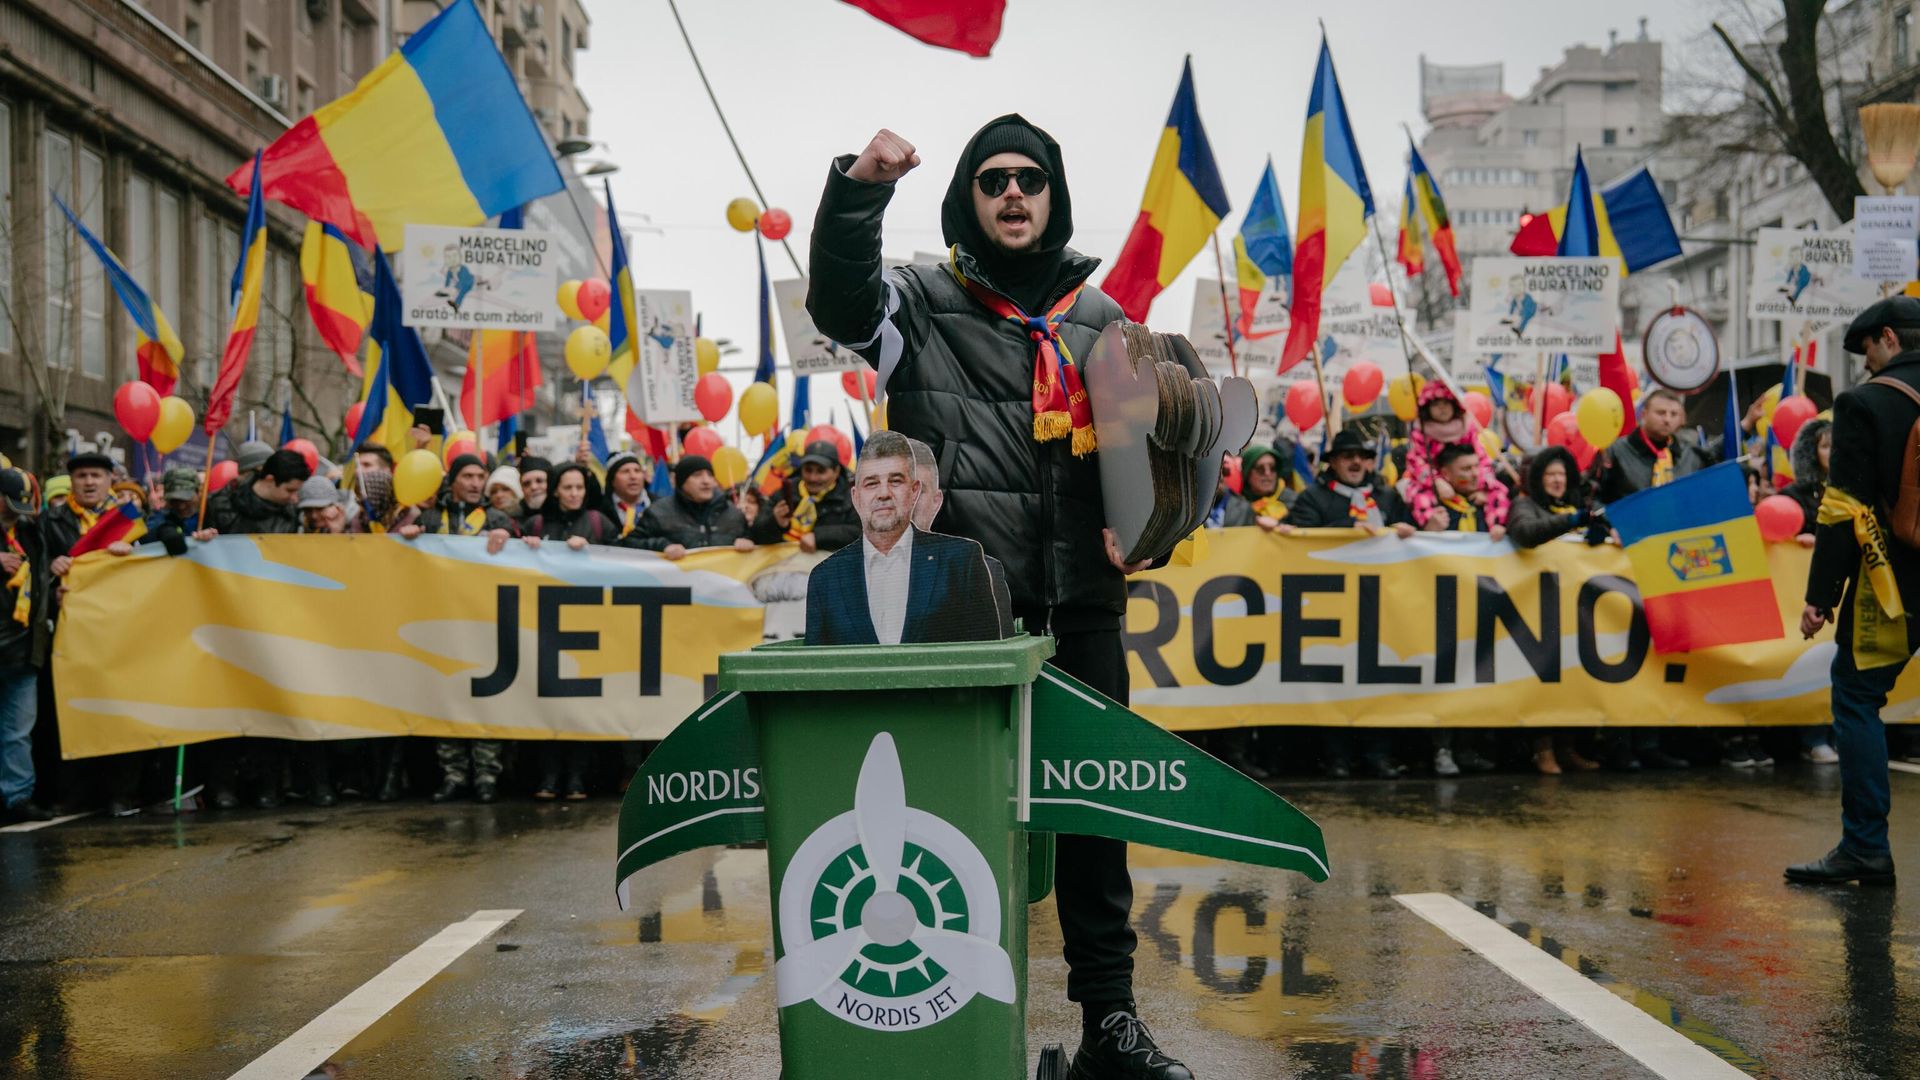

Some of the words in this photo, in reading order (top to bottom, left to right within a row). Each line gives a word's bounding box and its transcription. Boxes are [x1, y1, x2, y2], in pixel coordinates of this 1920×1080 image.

[459, 236, 547, 253] MARCELINO
[1802, 238, 1851, 250] MARCEL
[465, 251, 542, 266] BURATINO
[1805, 250, 1854, 264] BURATI
[1524, 265, 1609, 278] MARCELINO
[1528, 278, 1603, 292] BURATINO
[1806, 303, 1830, 315] cum
[474, 312, 503, 322] cum
[506, 311, 543, 324] zbori!
[1535, 336, 1563, 346] cum
[1121, 571, 1687, 688] RCELINO.
[1040, 759, 1187, 792] NORDIS
[647, 767, 760, 805] NORDIS
[836, 991, 921, 1027] NORDIS
[925, 986, 958, 1021] JET
